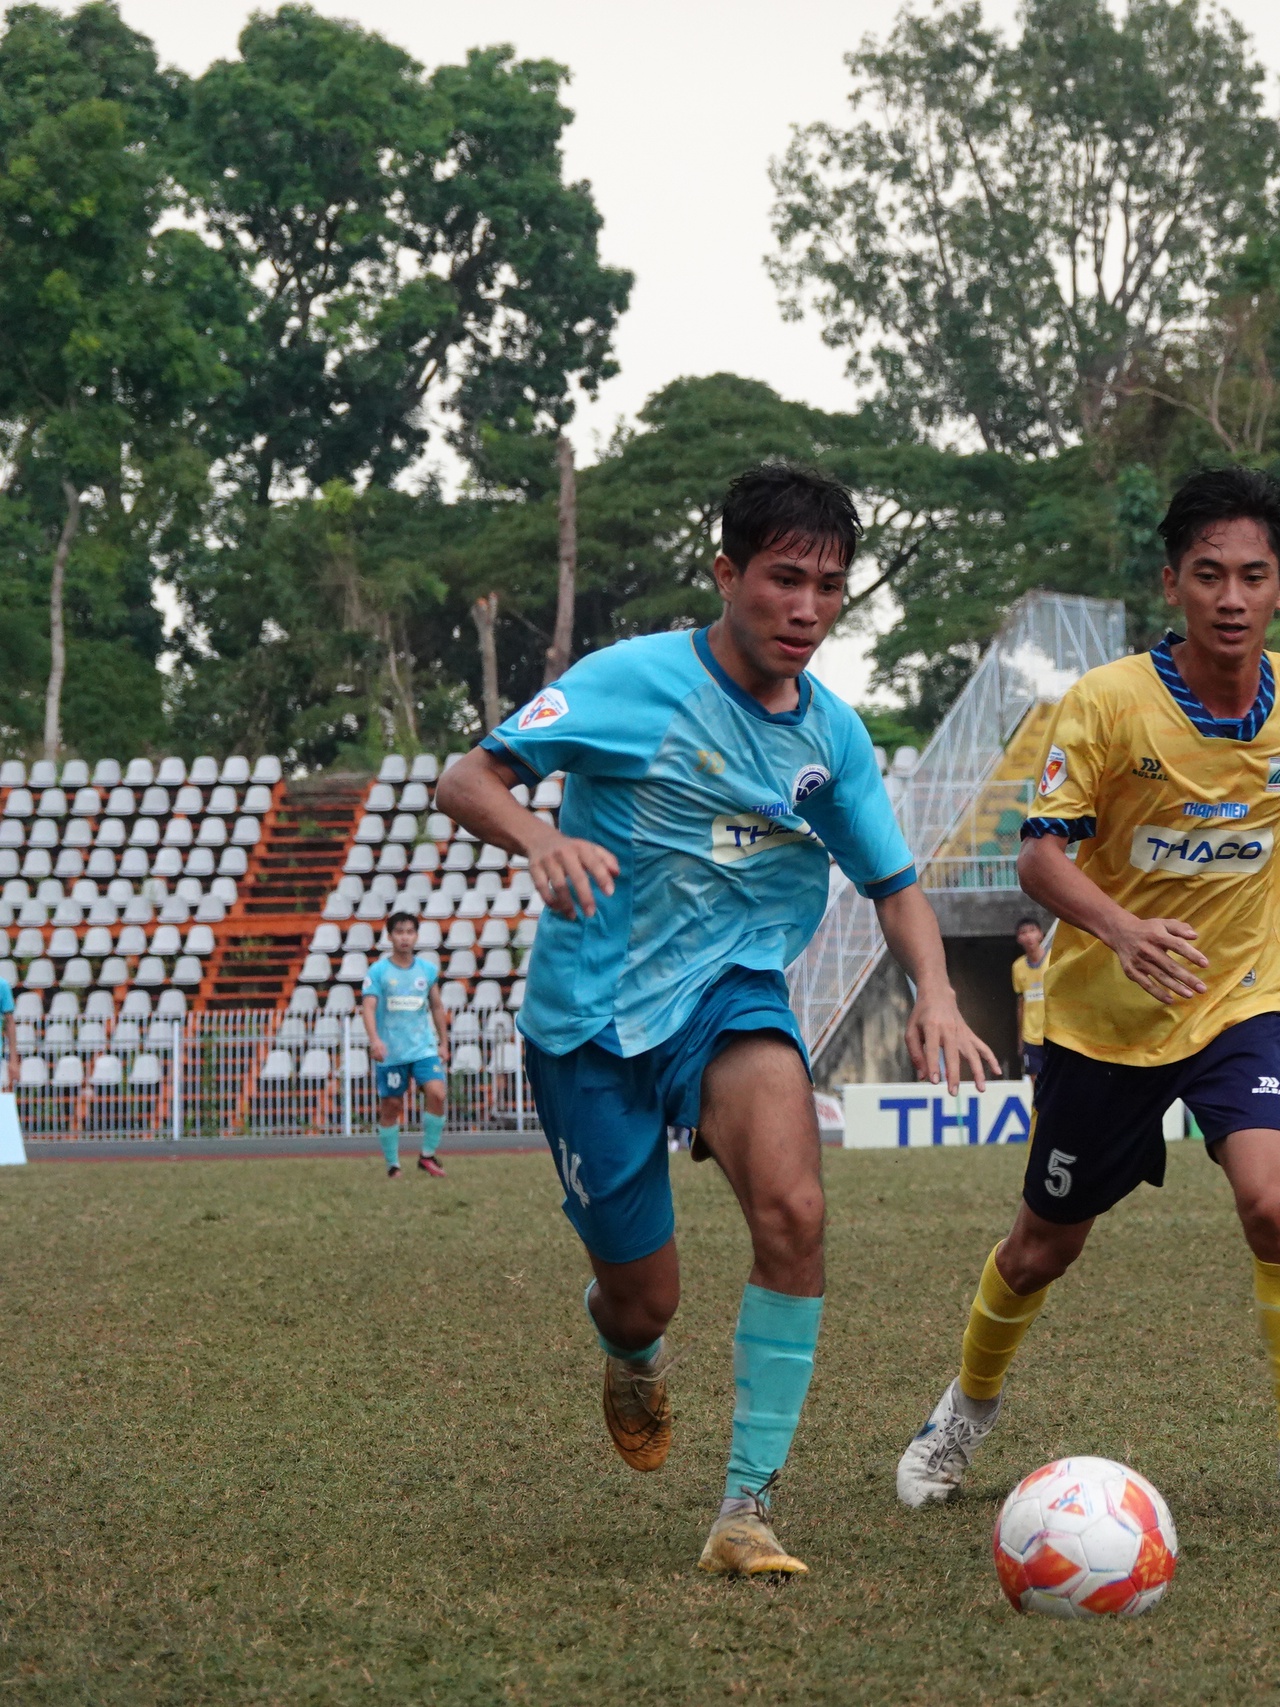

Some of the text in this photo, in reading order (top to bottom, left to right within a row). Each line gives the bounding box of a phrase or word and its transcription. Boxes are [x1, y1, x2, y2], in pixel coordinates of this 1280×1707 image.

[1147, 837, 1263, 864] THACO
[879, 1096, 1031, 1147] THA
[558, 1136, 590, 1209] 14
[1044, 1147, 1078, 1198] 5
